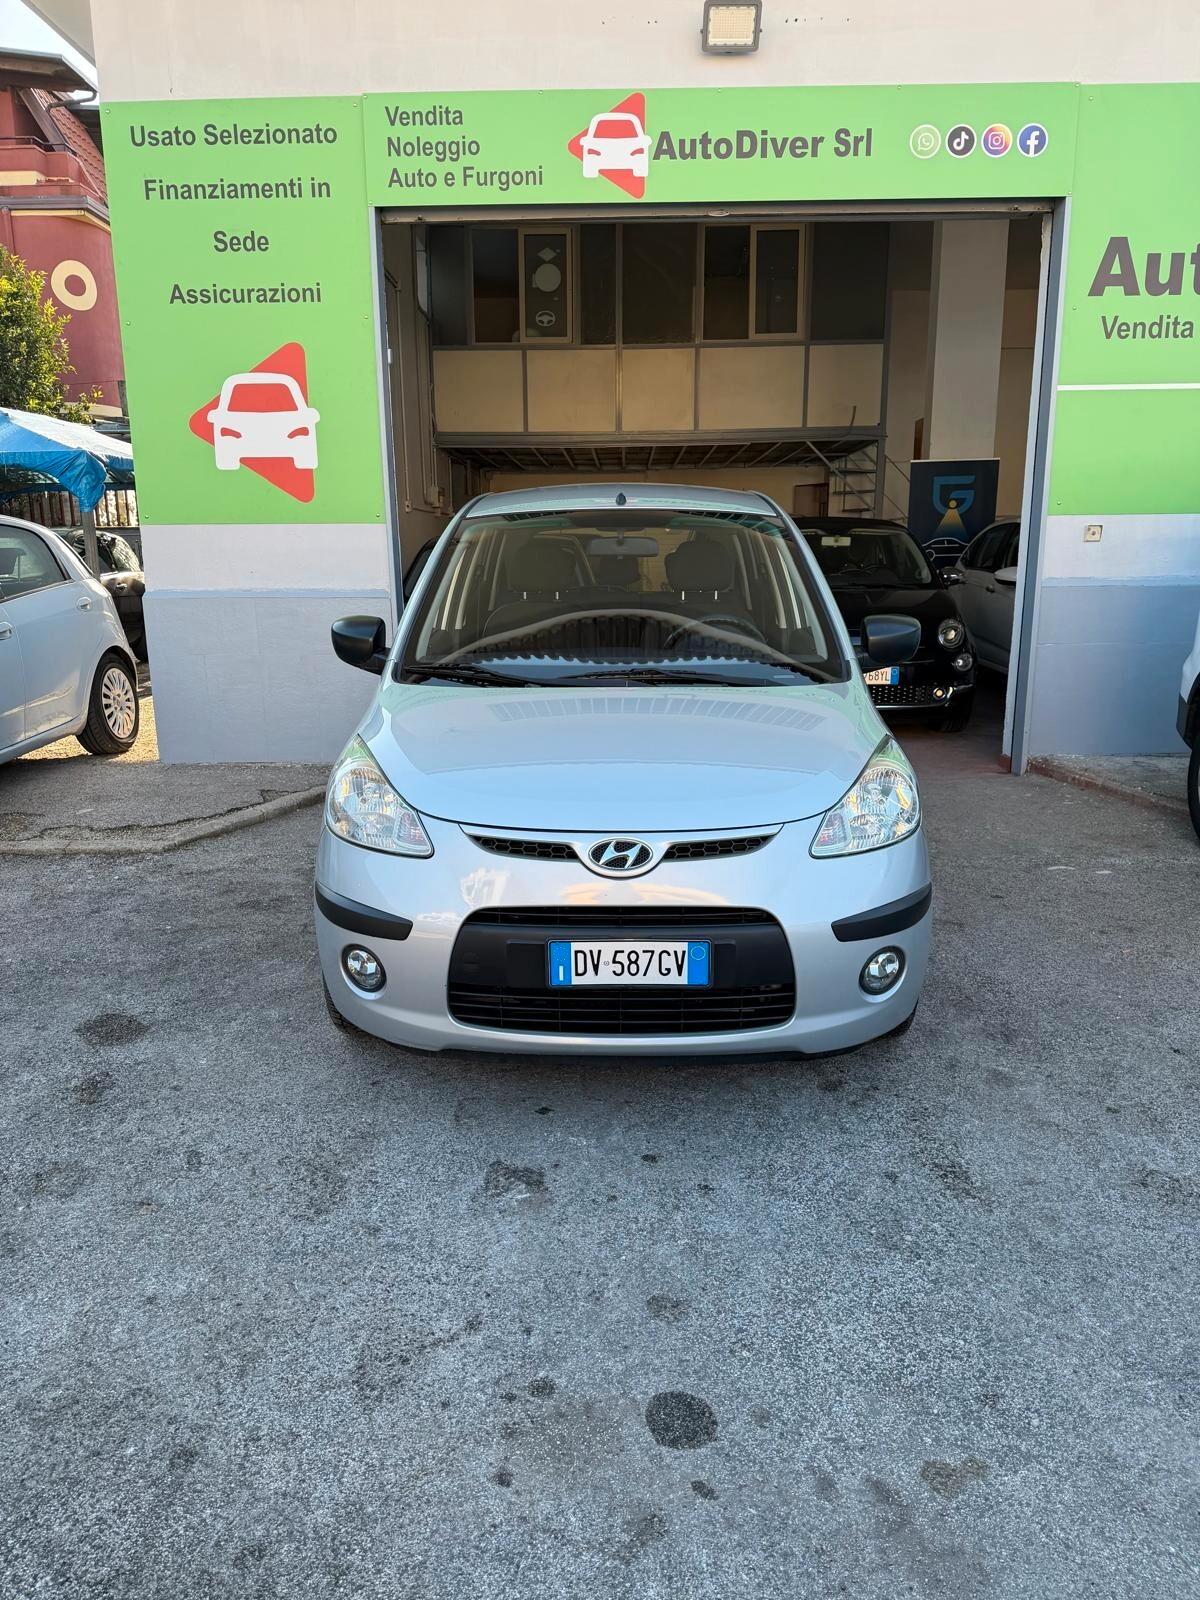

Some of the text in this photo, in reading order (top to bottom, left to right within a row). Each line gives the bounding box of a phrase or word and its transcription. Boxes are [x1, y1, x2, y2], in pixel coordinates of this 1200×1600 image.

[385, 105, 464, 127] Vendita
[130, 123, 338, 148] Usato Selezionato
[652, 128, 873, 161] AutoDiver Srl
[387, 135, 481, 163] Noleggio
[143, 177, 331, 201] Finanziamenti in
[387, 165, 543, 191] Auto e Furgoni
[213, 230, 270, 252] Sede
[169, 282, 322, 305] Assicurazioni
[1101, 314, 1194, 340] Vendita
[574, 949, 602, 977] DV
[611, 949, 687, 977] 587GV
